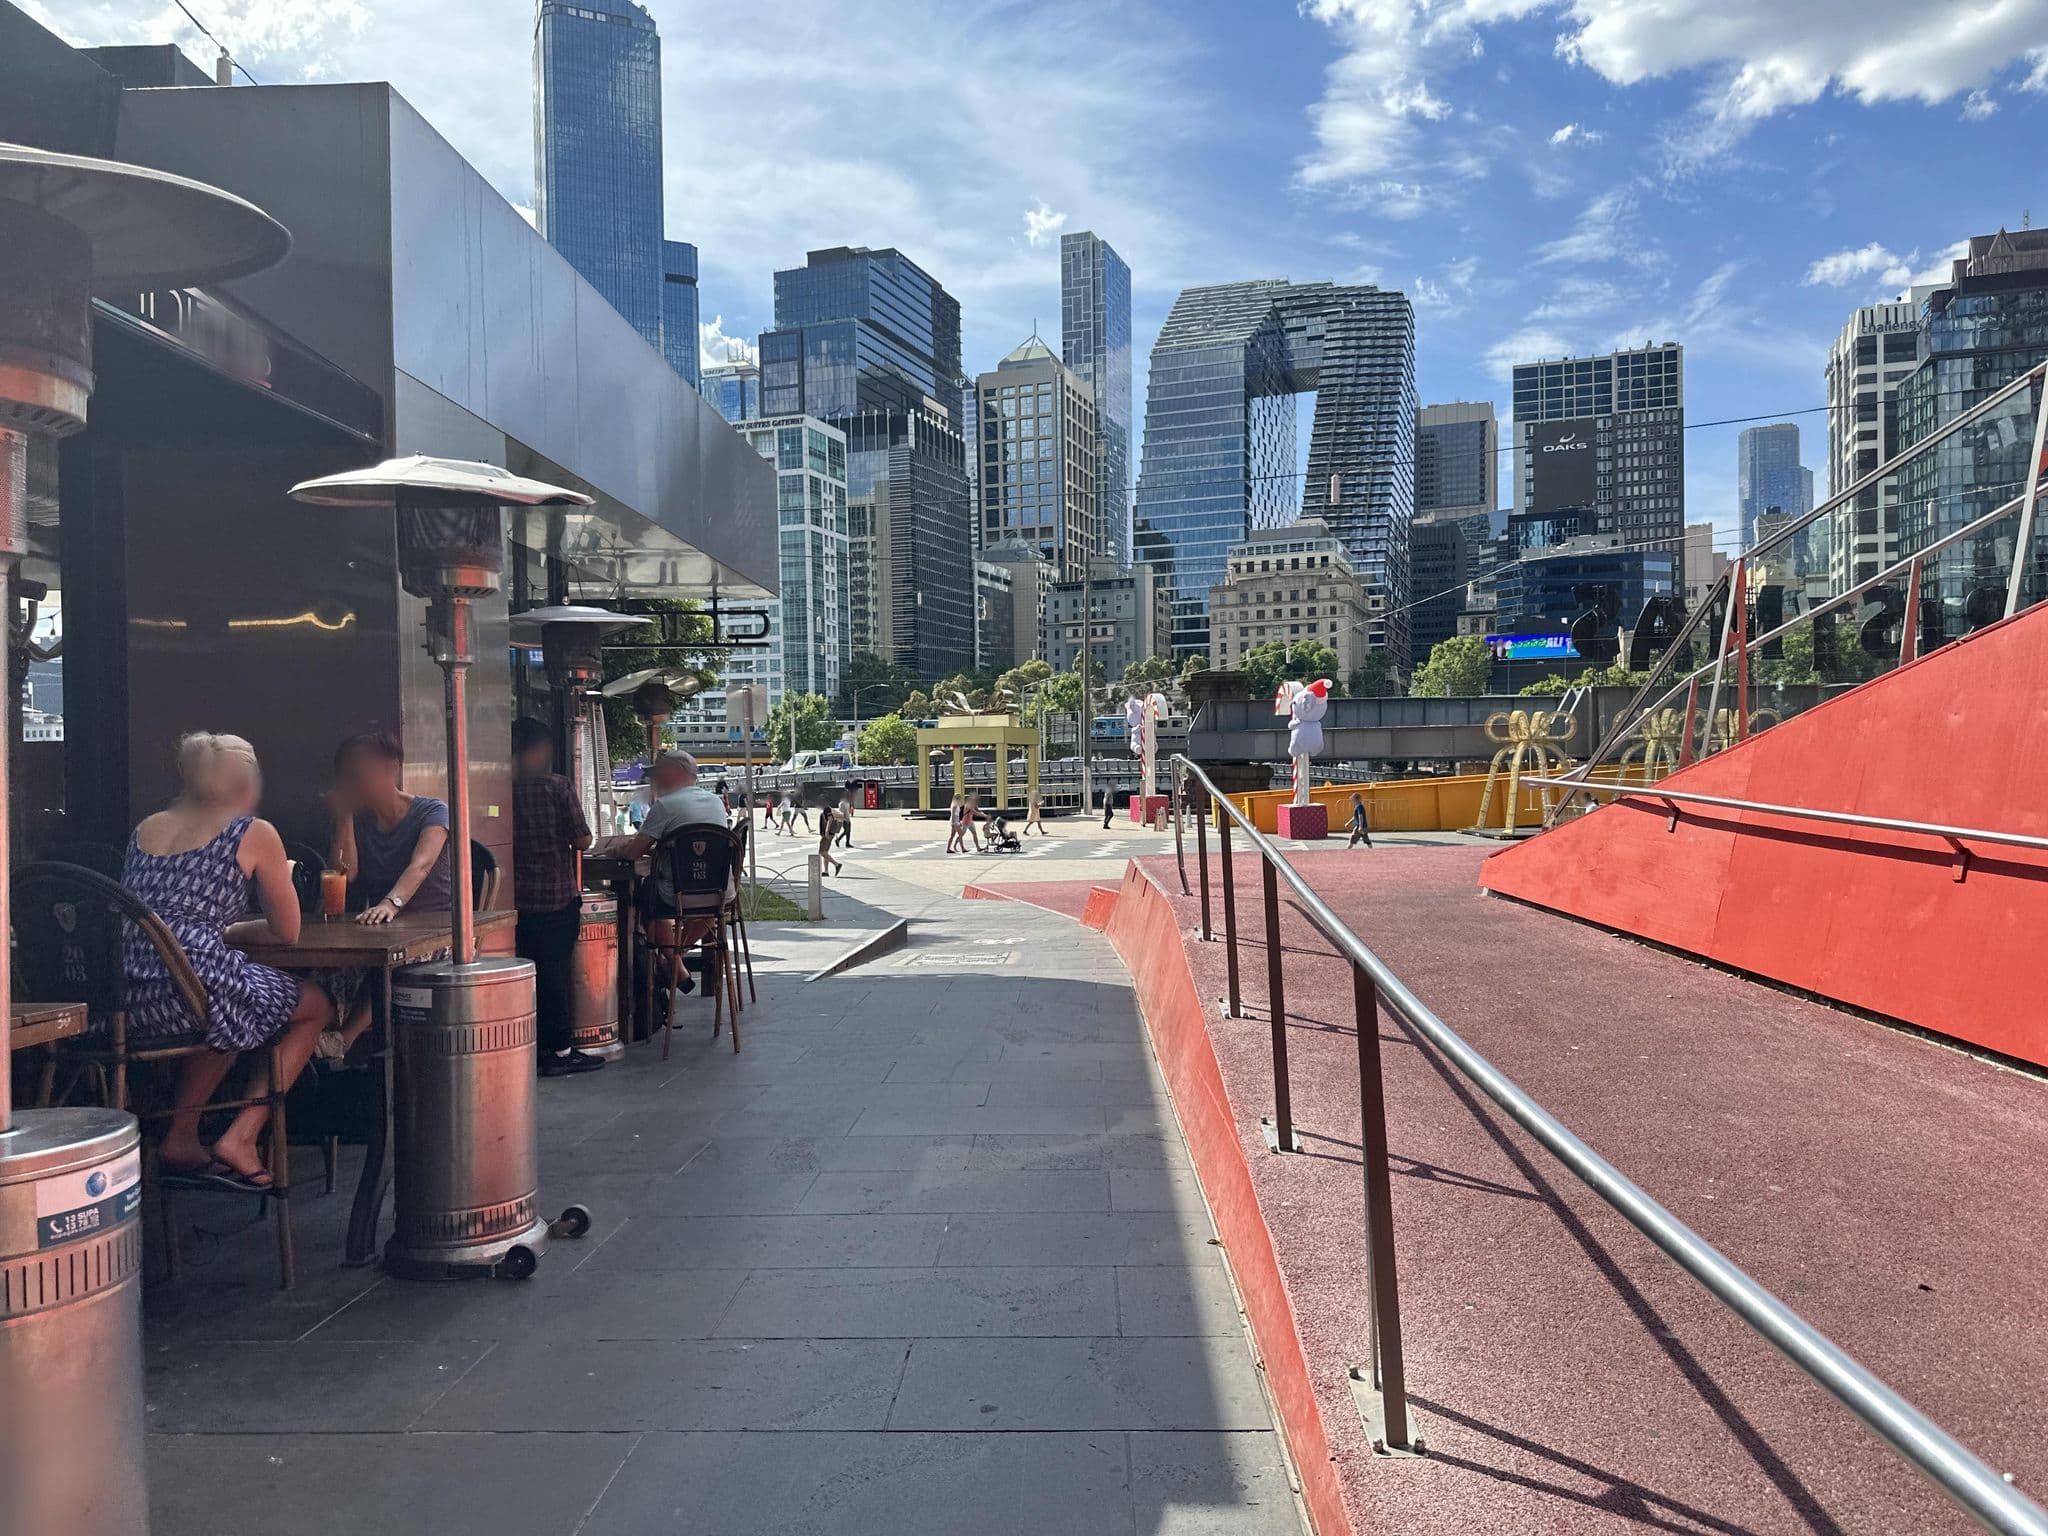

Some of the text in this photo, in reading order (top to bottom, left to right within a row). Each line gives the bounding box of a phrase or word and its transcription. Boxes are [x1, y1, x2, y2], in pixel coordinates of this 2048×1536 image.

[771, 418, 804, 427] GATEWAY
[1543, 442, 1587, 452] OAKS
[77, 1207, 99, 1219] SUPA
